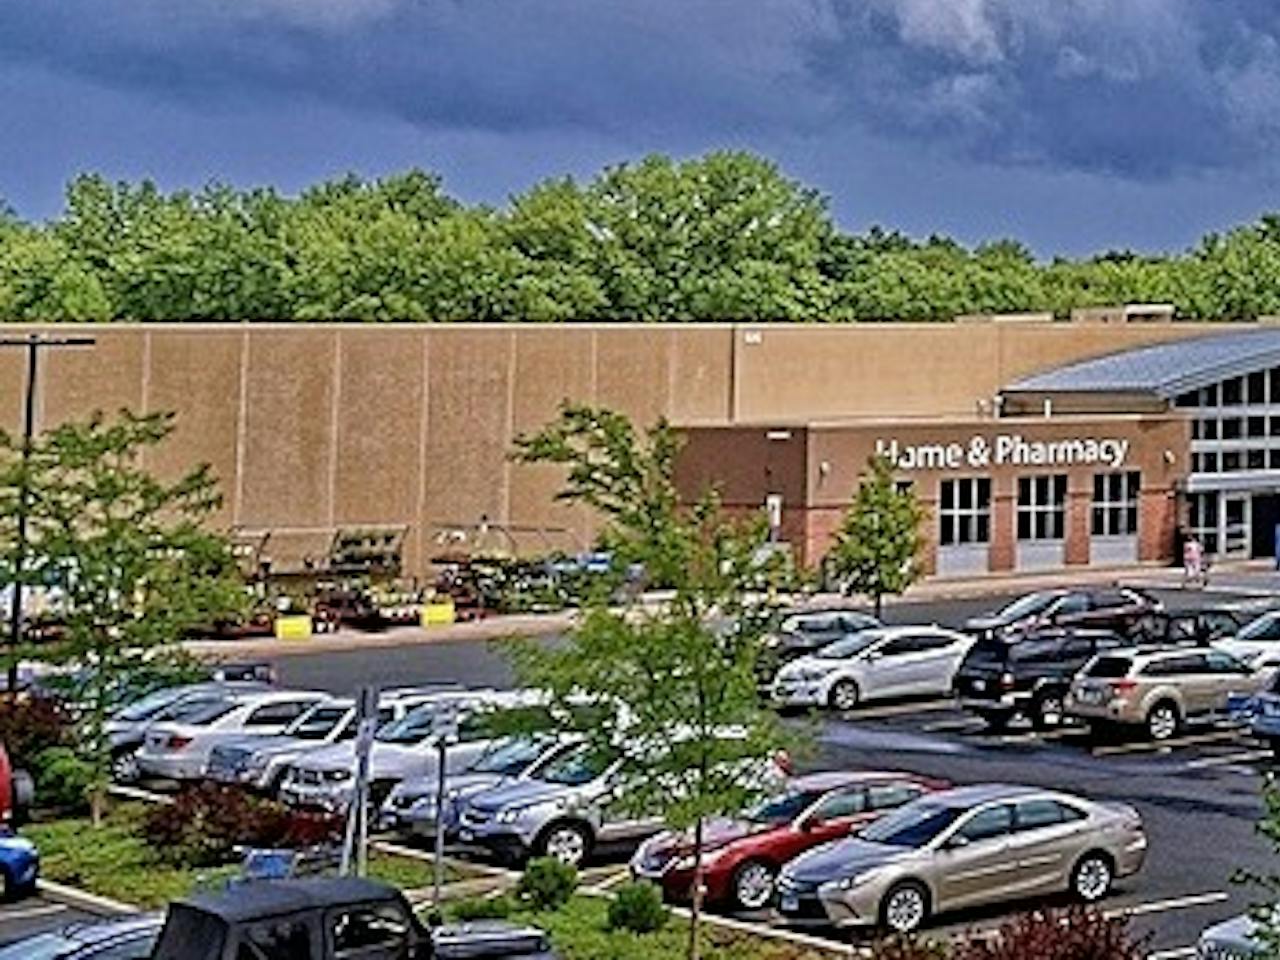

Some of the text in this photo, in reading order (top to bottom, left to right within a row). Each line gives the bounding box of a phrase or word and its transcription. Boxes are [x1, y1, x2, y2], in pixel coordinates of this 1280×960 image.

[876, 434, 1129, 468] Home & Pharmacy
